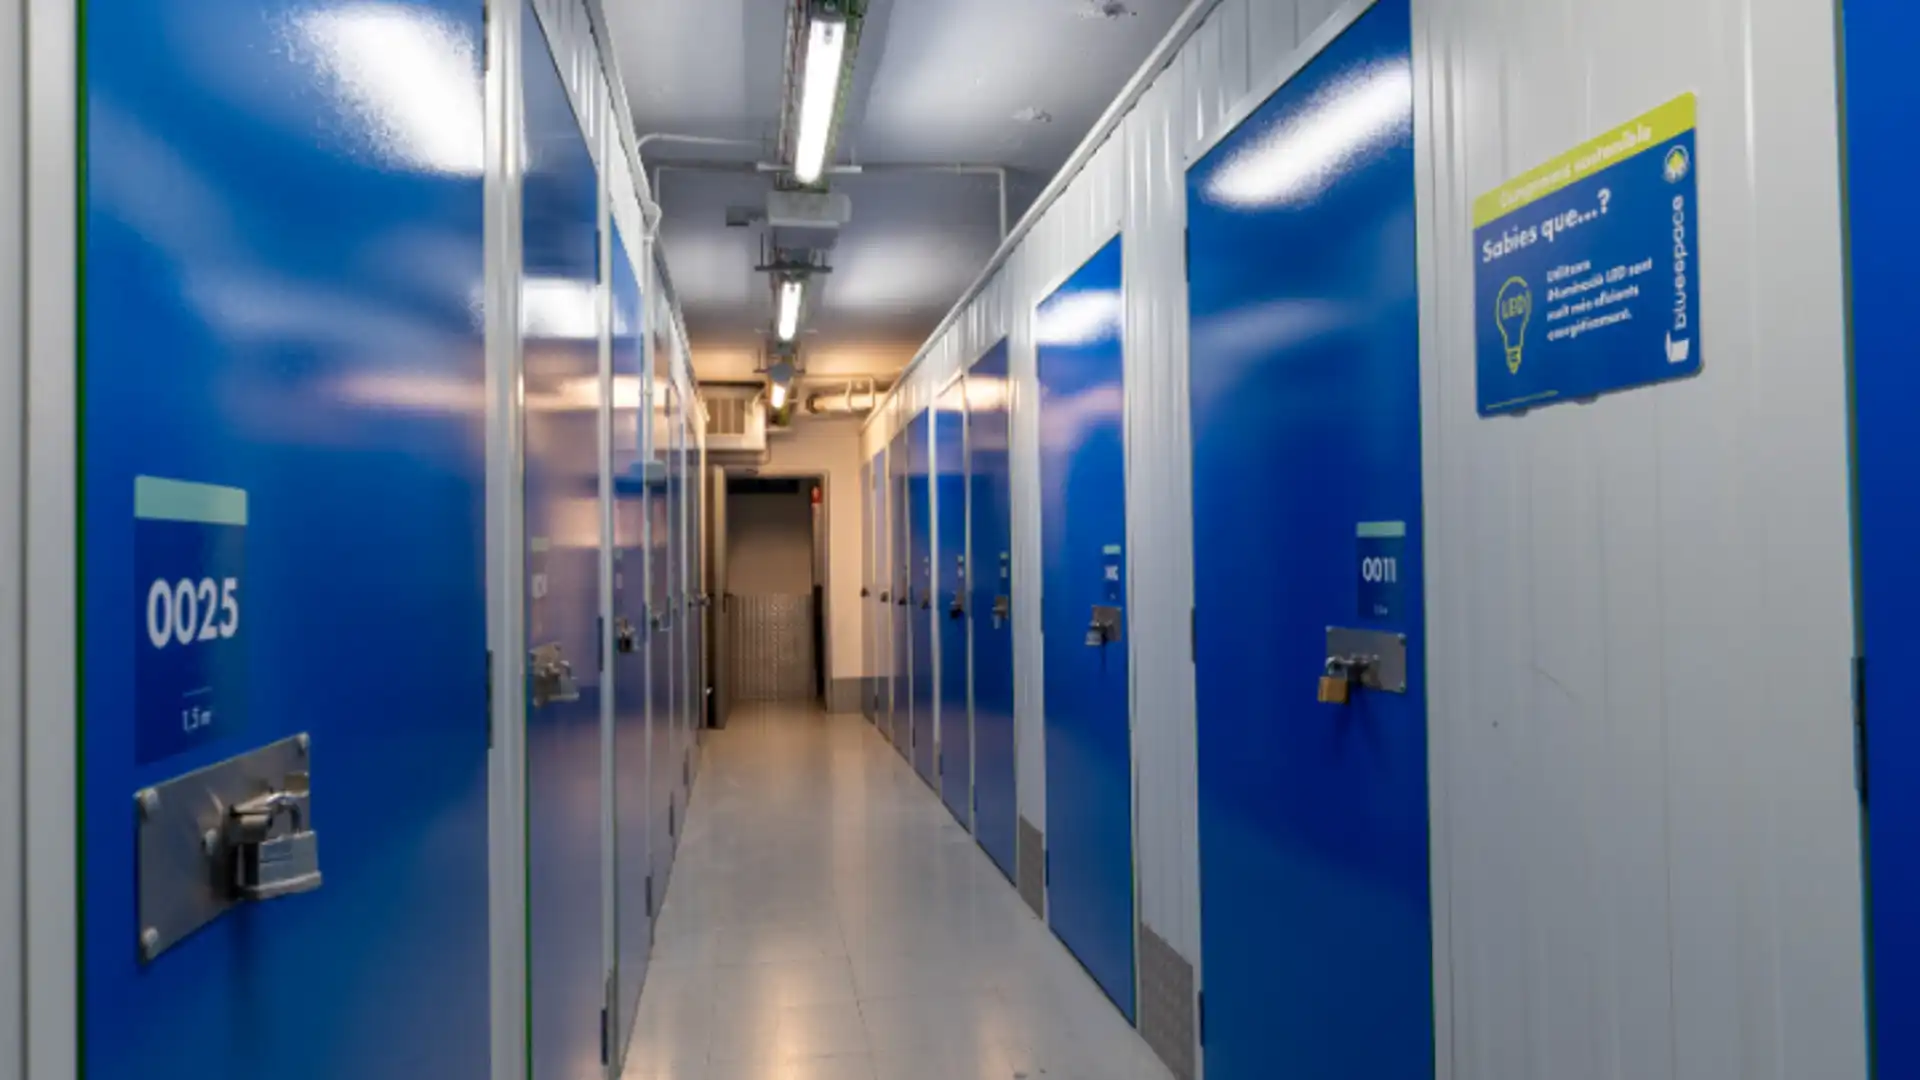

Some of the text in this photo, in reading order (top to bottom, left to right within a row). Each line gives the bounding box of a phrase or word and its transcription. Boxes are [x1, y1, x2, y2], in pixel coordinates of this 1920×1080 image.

[1483, 224, 1537, 262] Sabies
[1672, 195, 1687, 330] bluespace
[1502, 295, 1525, 319] LED
[1362, 556, 1396, 582] 0011
[147, 577, 239, 648] 0025
